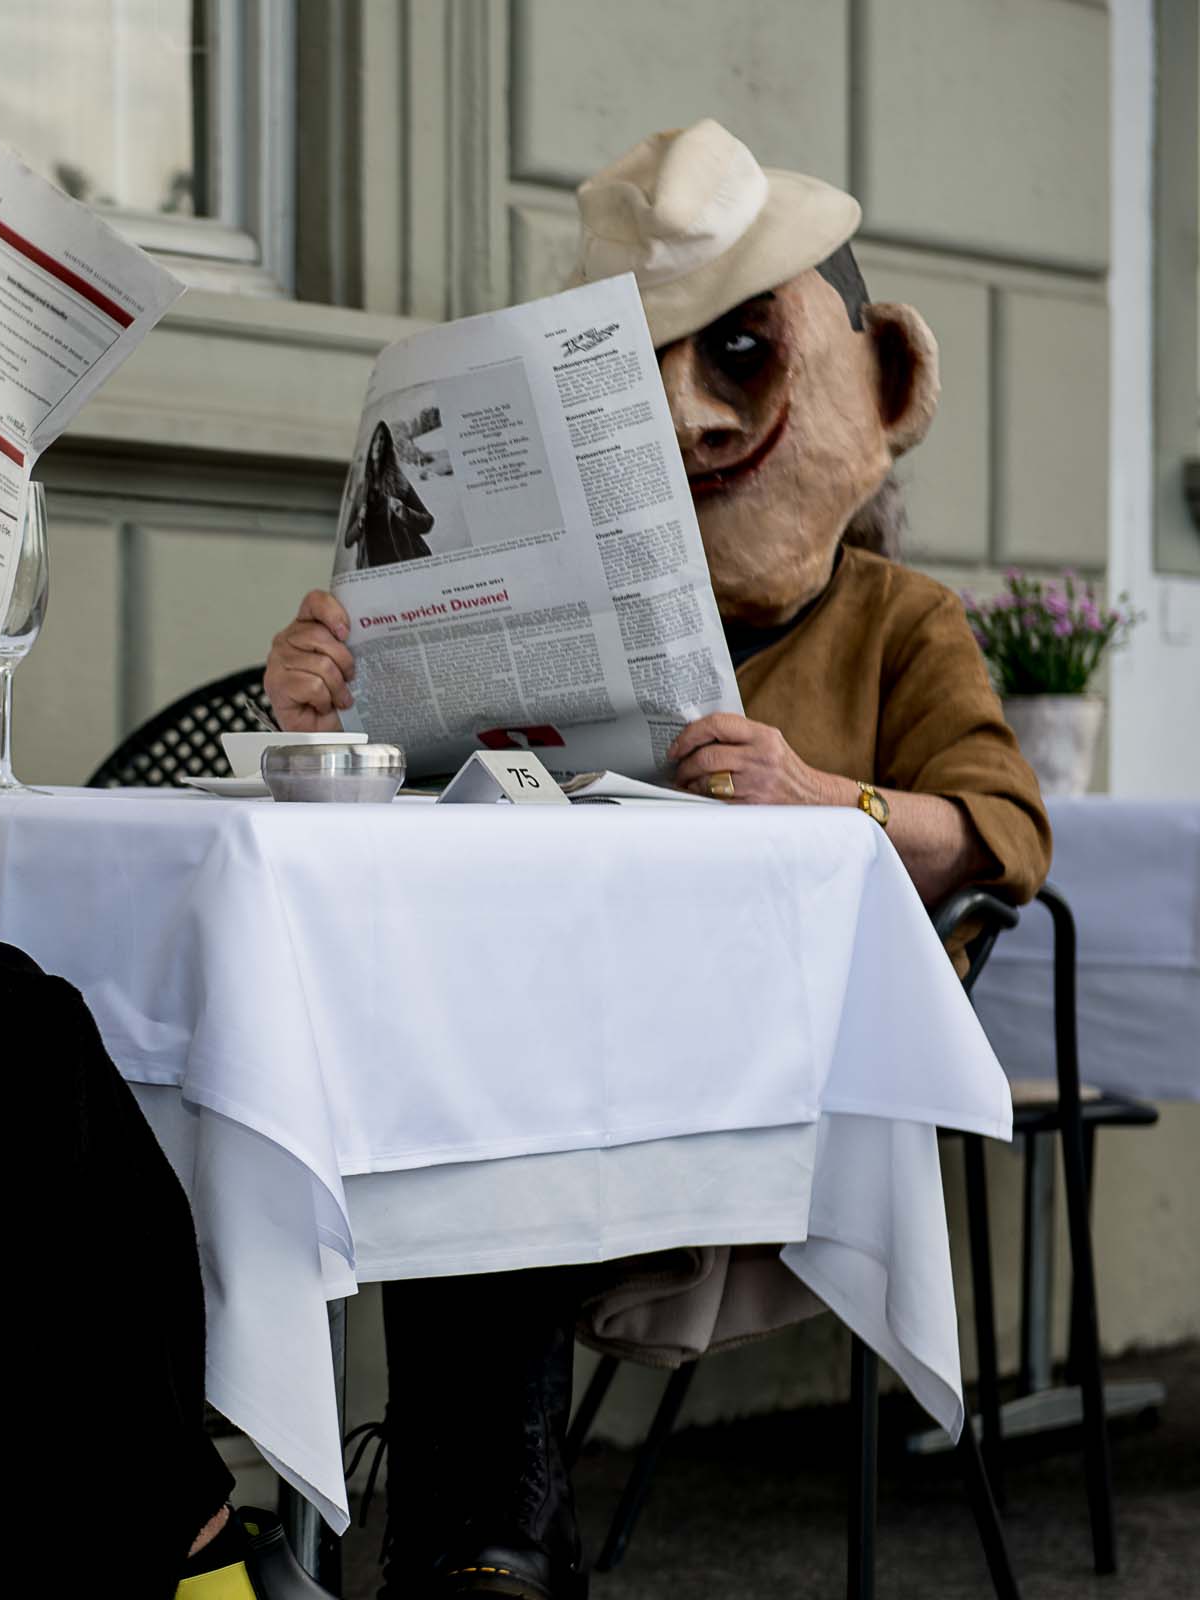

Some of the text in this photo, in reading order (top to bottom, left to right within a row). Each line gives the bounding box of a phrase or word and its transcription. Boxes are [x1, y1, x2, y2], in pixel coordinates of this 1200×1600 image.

[359, 613, 398, 629] Dann
[400, 602, 448, 622] spricht
[450, 589, 509, 613] Duvanel
[507, 768, 540, 788] 75
